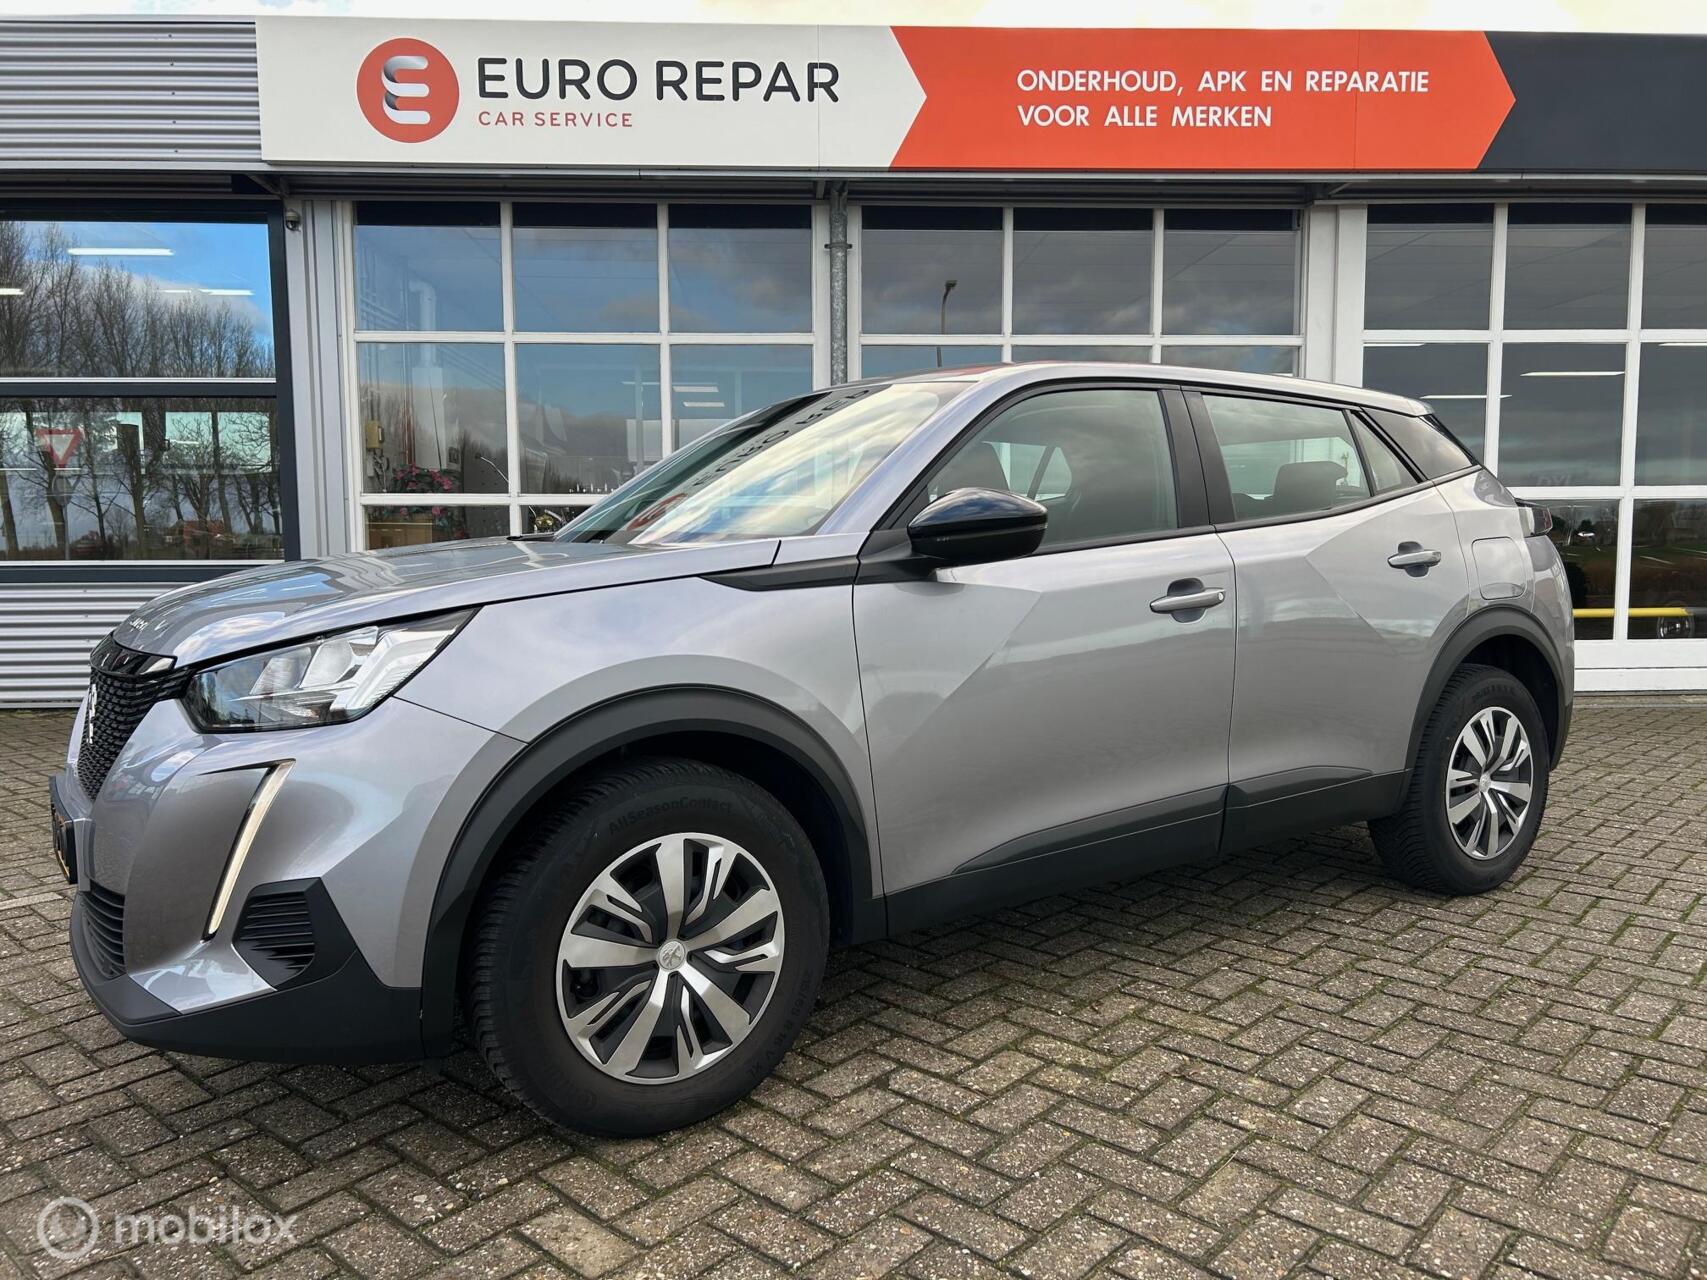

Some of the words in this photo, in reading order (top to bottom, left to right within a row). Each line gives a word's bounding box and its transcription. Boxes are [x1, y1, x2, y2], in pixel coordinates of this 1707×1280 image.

[478, 57, 637, 101] EURO
[655, 60, 840, 103] REPAR
[1017, 69, 1183, 96] ONDERHOUD,
[1198, 70, 1247, 92] APK
[1261, 70, 1292, 92] EN
[1305, 70, 1429, 93] REPARATIE
[478, 111, 525, 127] CAR
[534, 111, 633, 129] SERVICE
[1017, 104, 1090, 127] VOOR
[1104, 105, 1158, 127] ALLE
[1171, 105, 1272, 127] MERKEN
